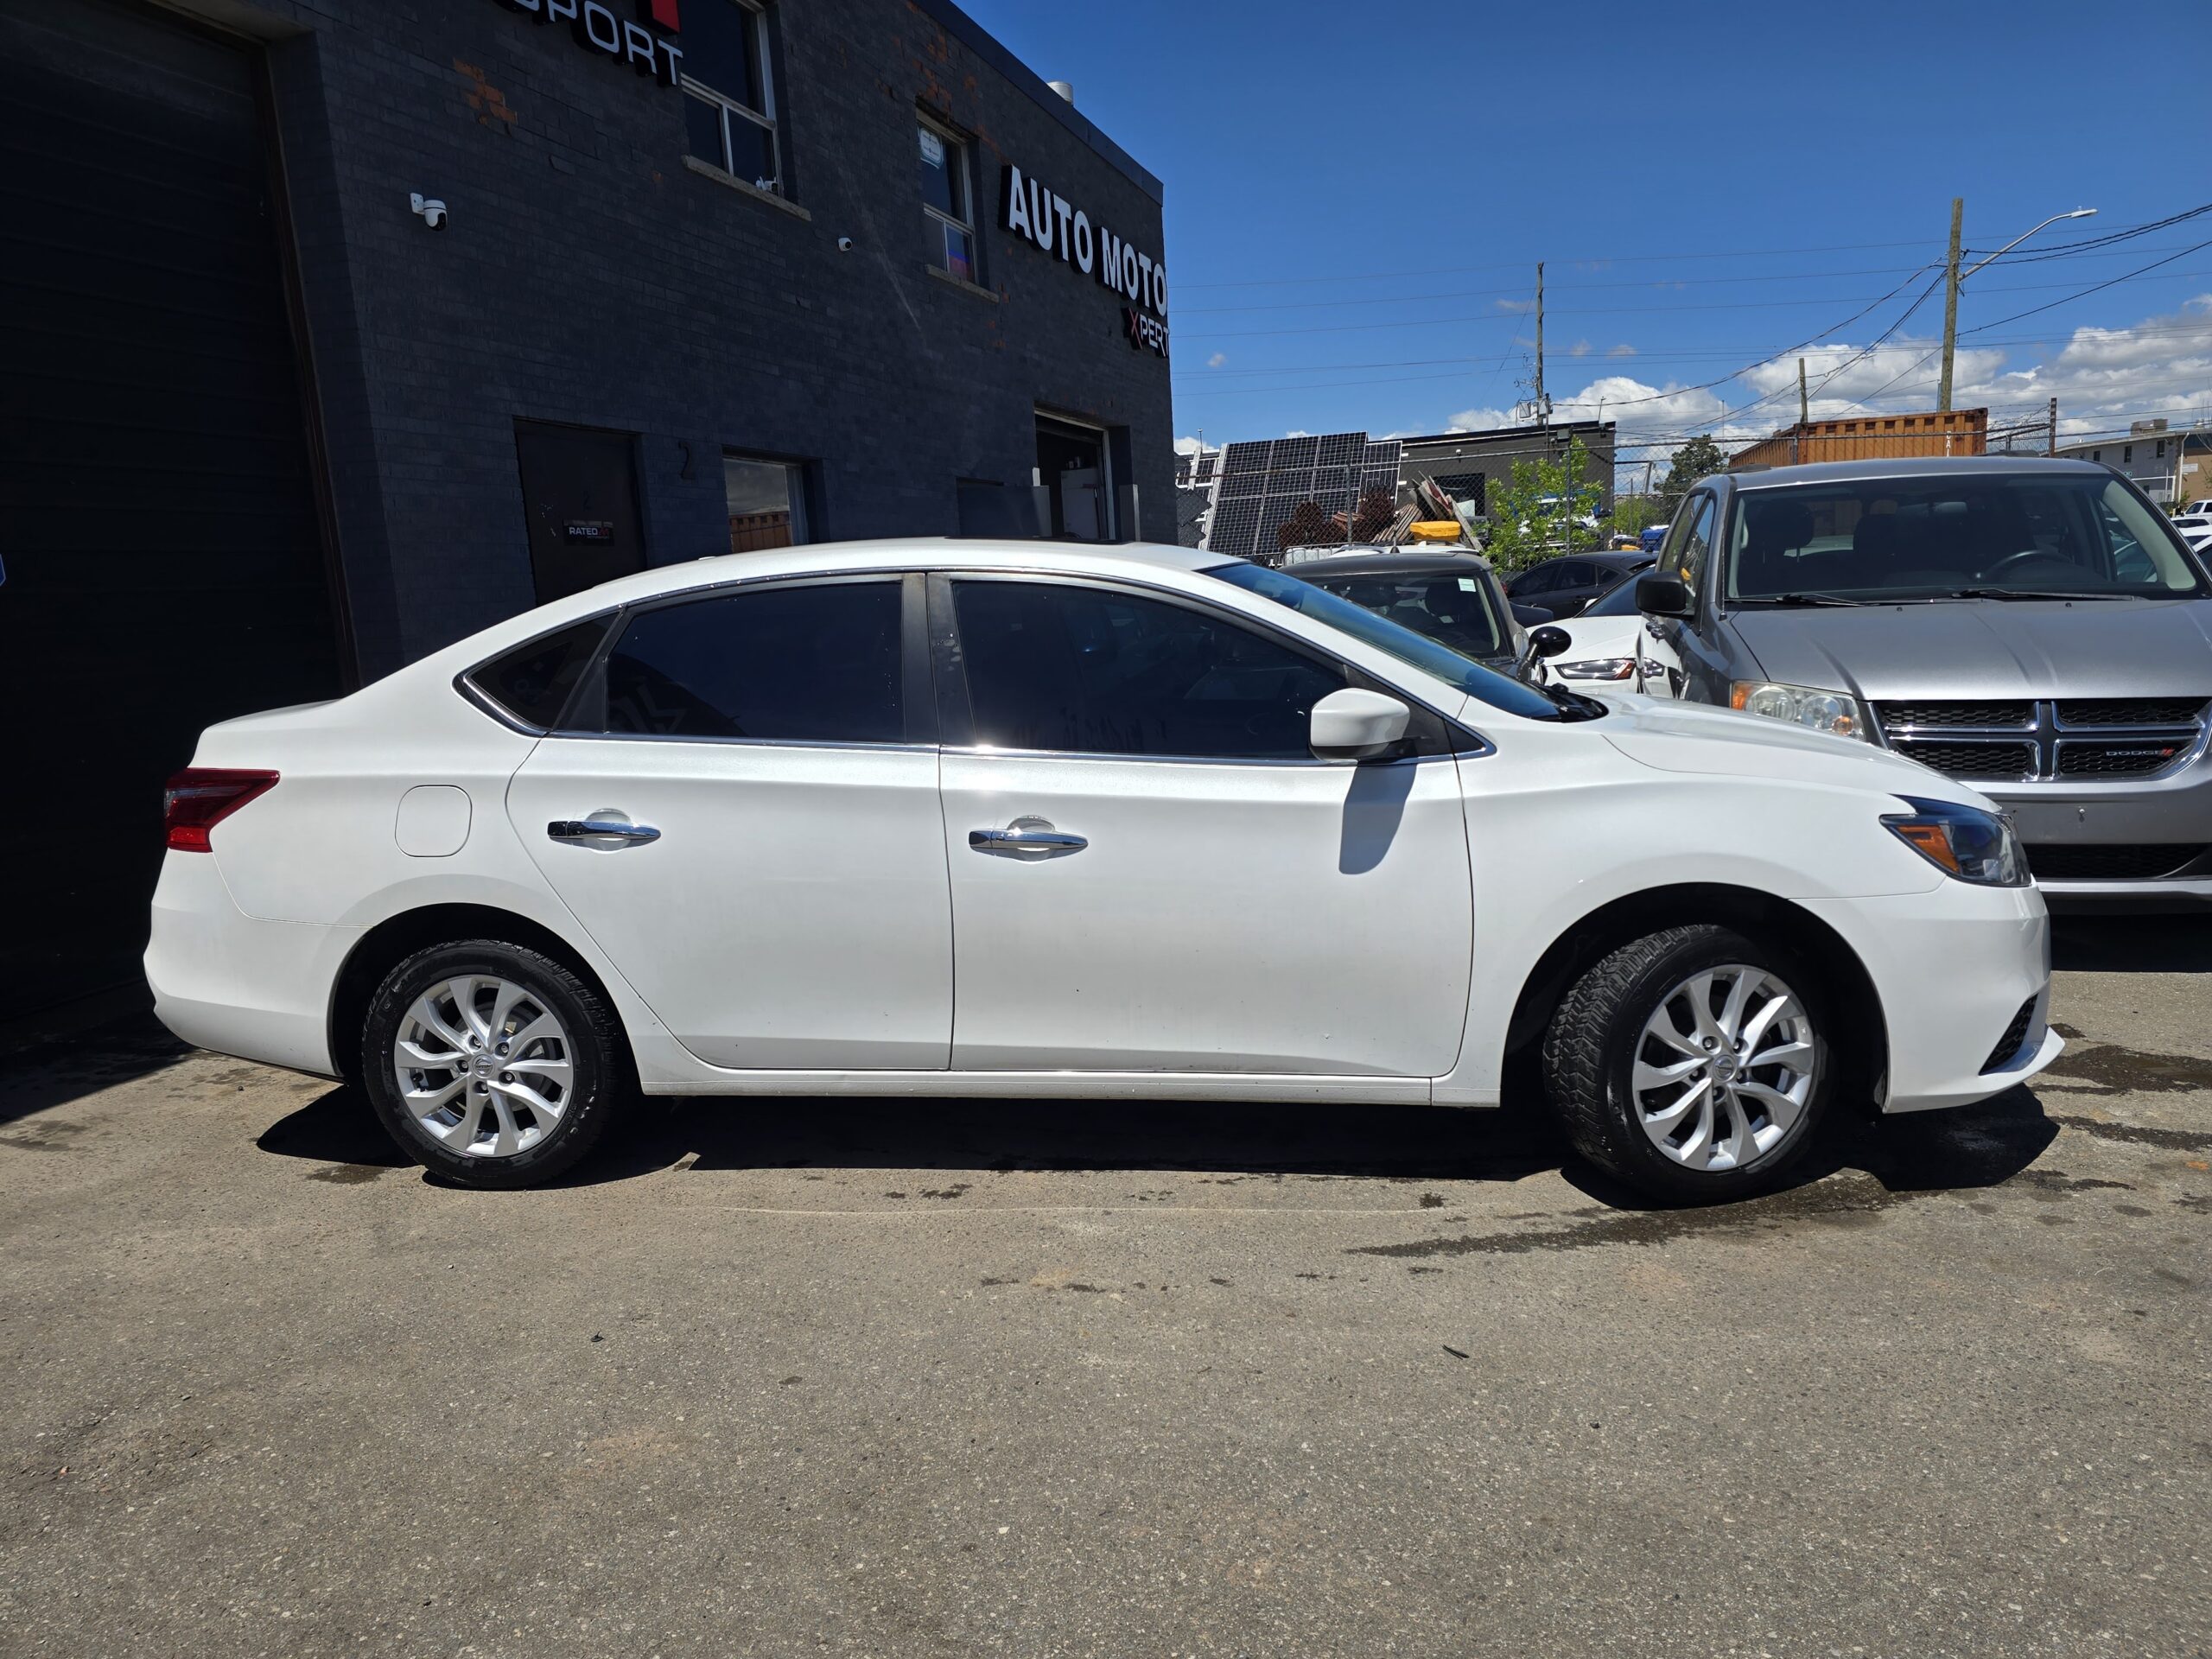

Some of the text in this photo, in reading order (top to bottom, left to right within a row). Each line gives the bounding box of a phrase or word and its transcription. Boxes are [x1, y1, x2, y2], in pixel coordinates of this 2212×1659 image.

[513, 0, 683, 86] PORT
[1008, 164, 1167, 316] AUTO MOTO
[1128, 306, 1169, 357] XPERT
[678, 441, 695, 480] 2
[569, 526, 599, 536] RATED
